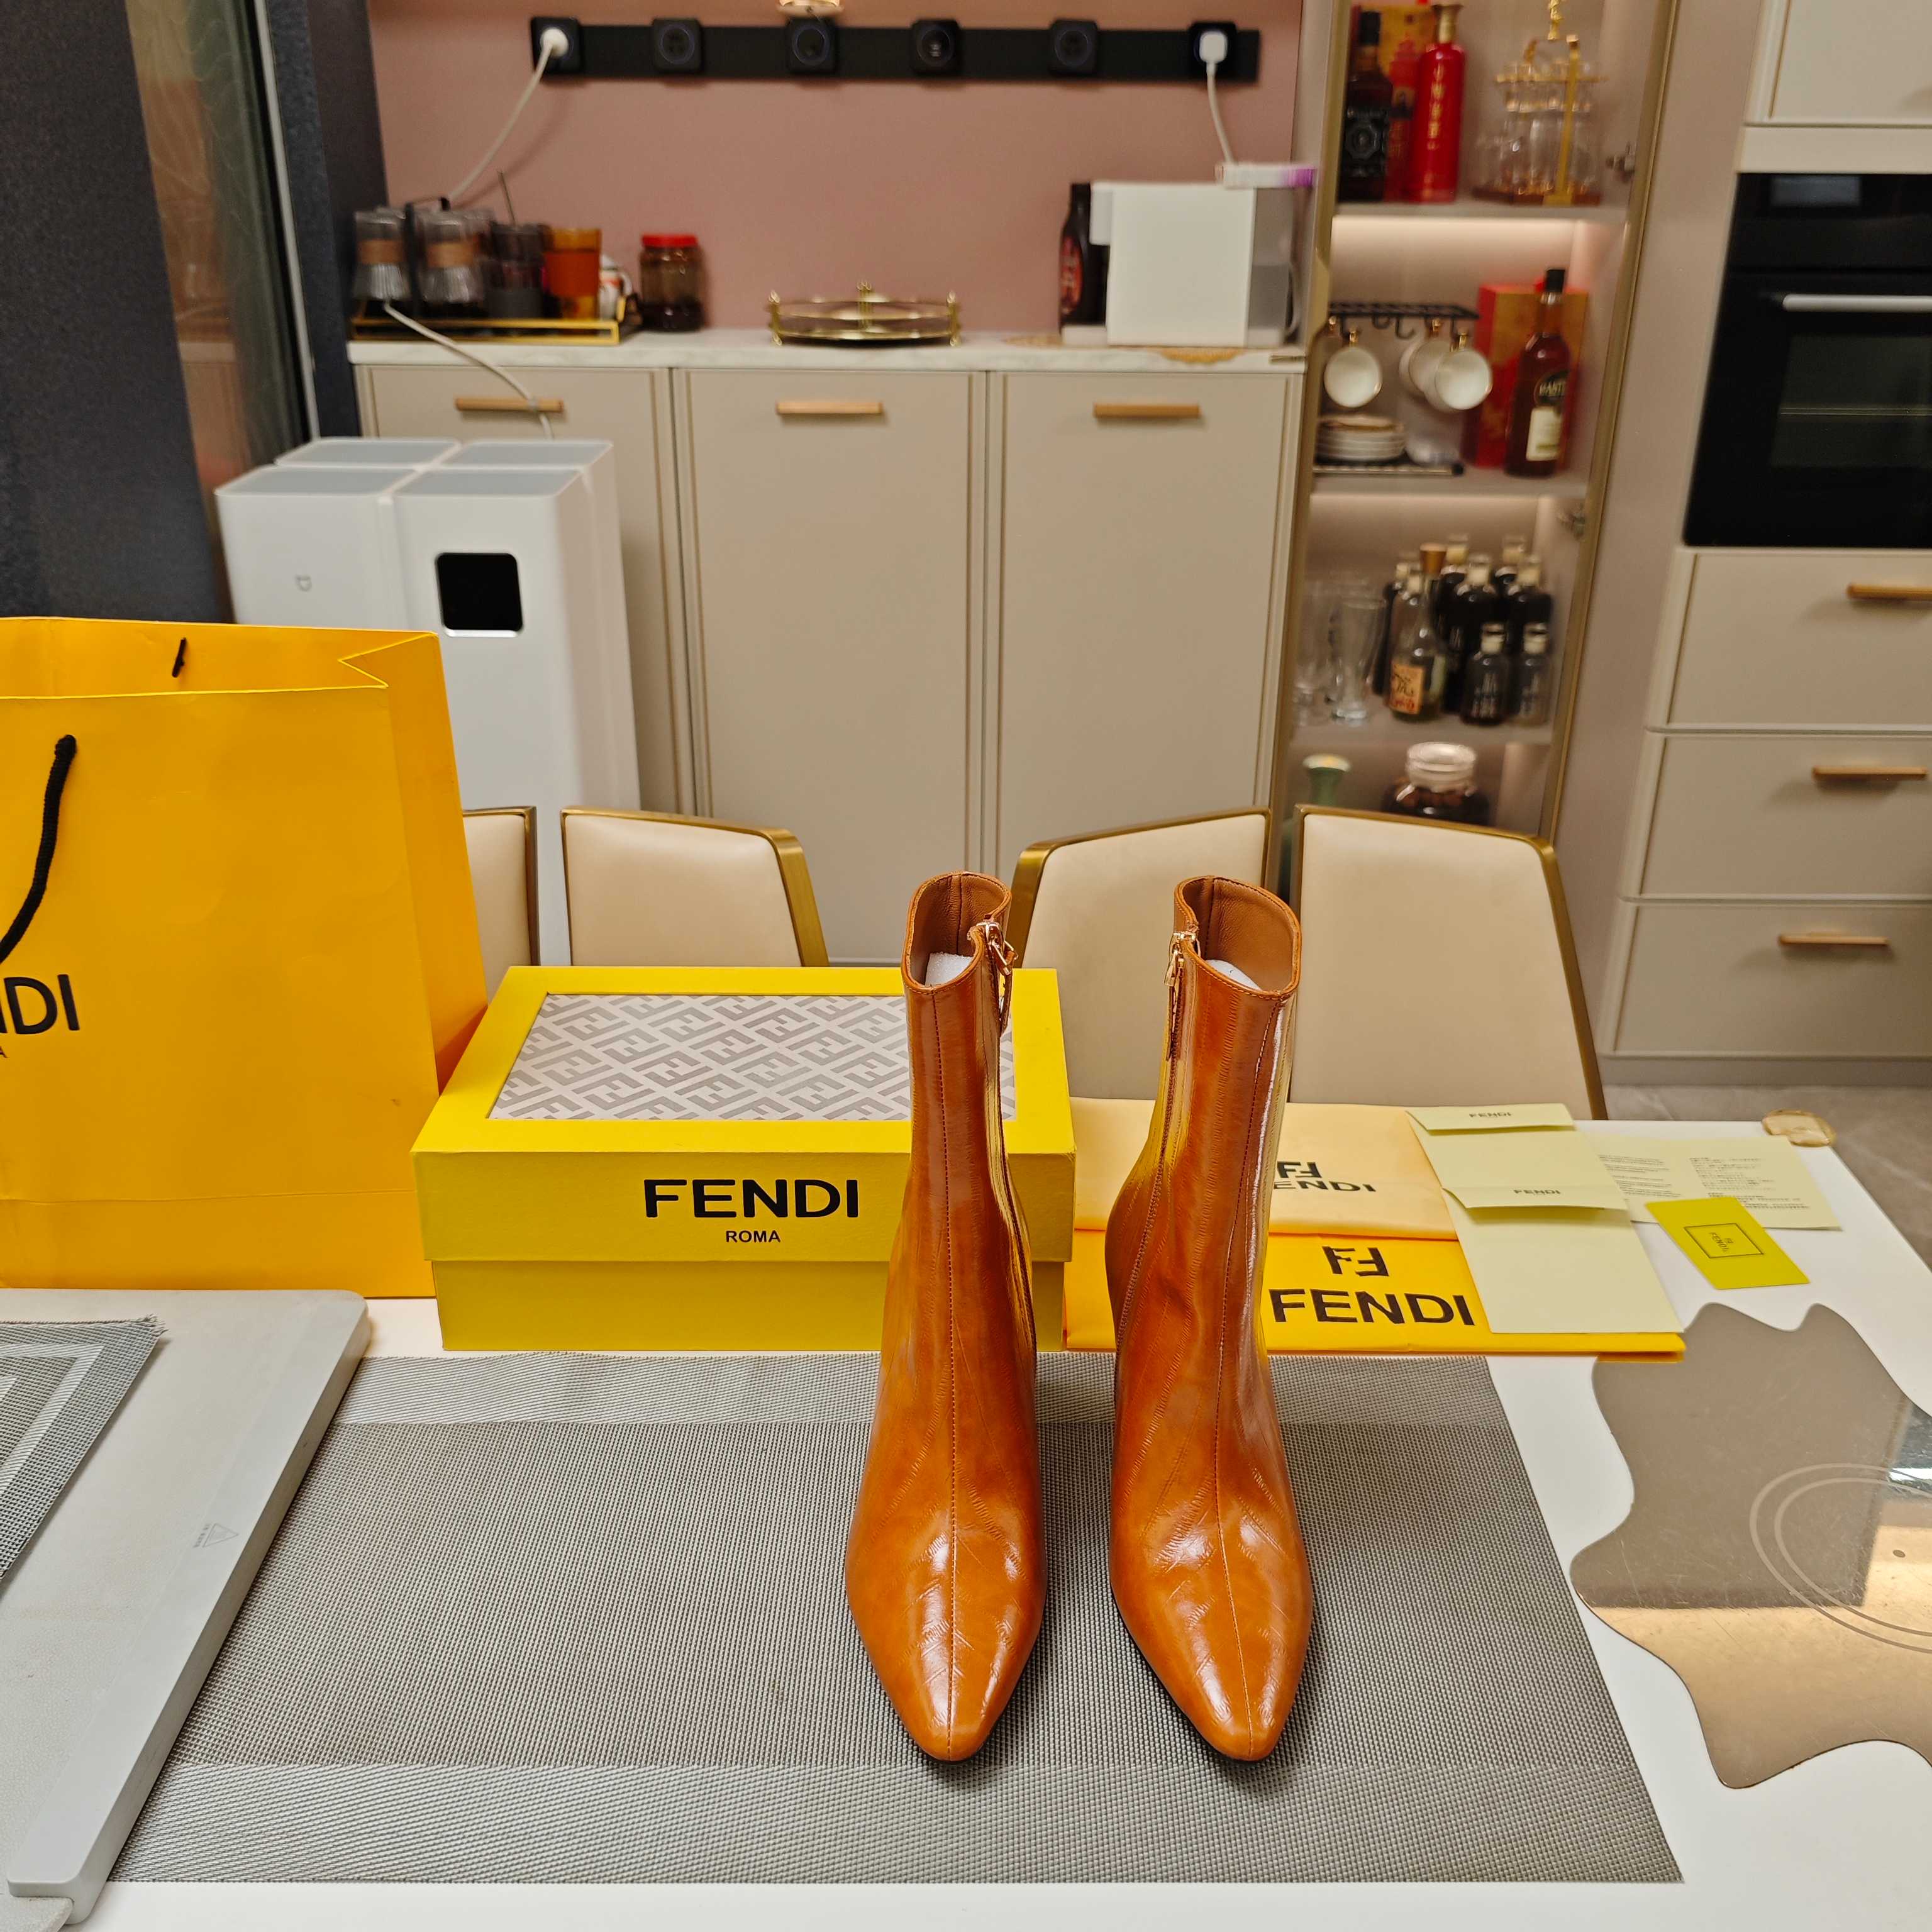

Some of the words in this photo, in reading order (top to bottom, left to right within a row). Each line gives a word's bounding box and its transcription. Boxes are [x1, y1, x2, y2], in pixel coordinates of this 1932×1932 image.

[0, 974, 80, 1035] DI
[643, 1179, 858, 1218] FENDI
[1273, 1180, 1377, 1192] ENDI
[725, 1230, 781, 1243] ROMA
[1269, 1288, 1475, 1326] FENDI
